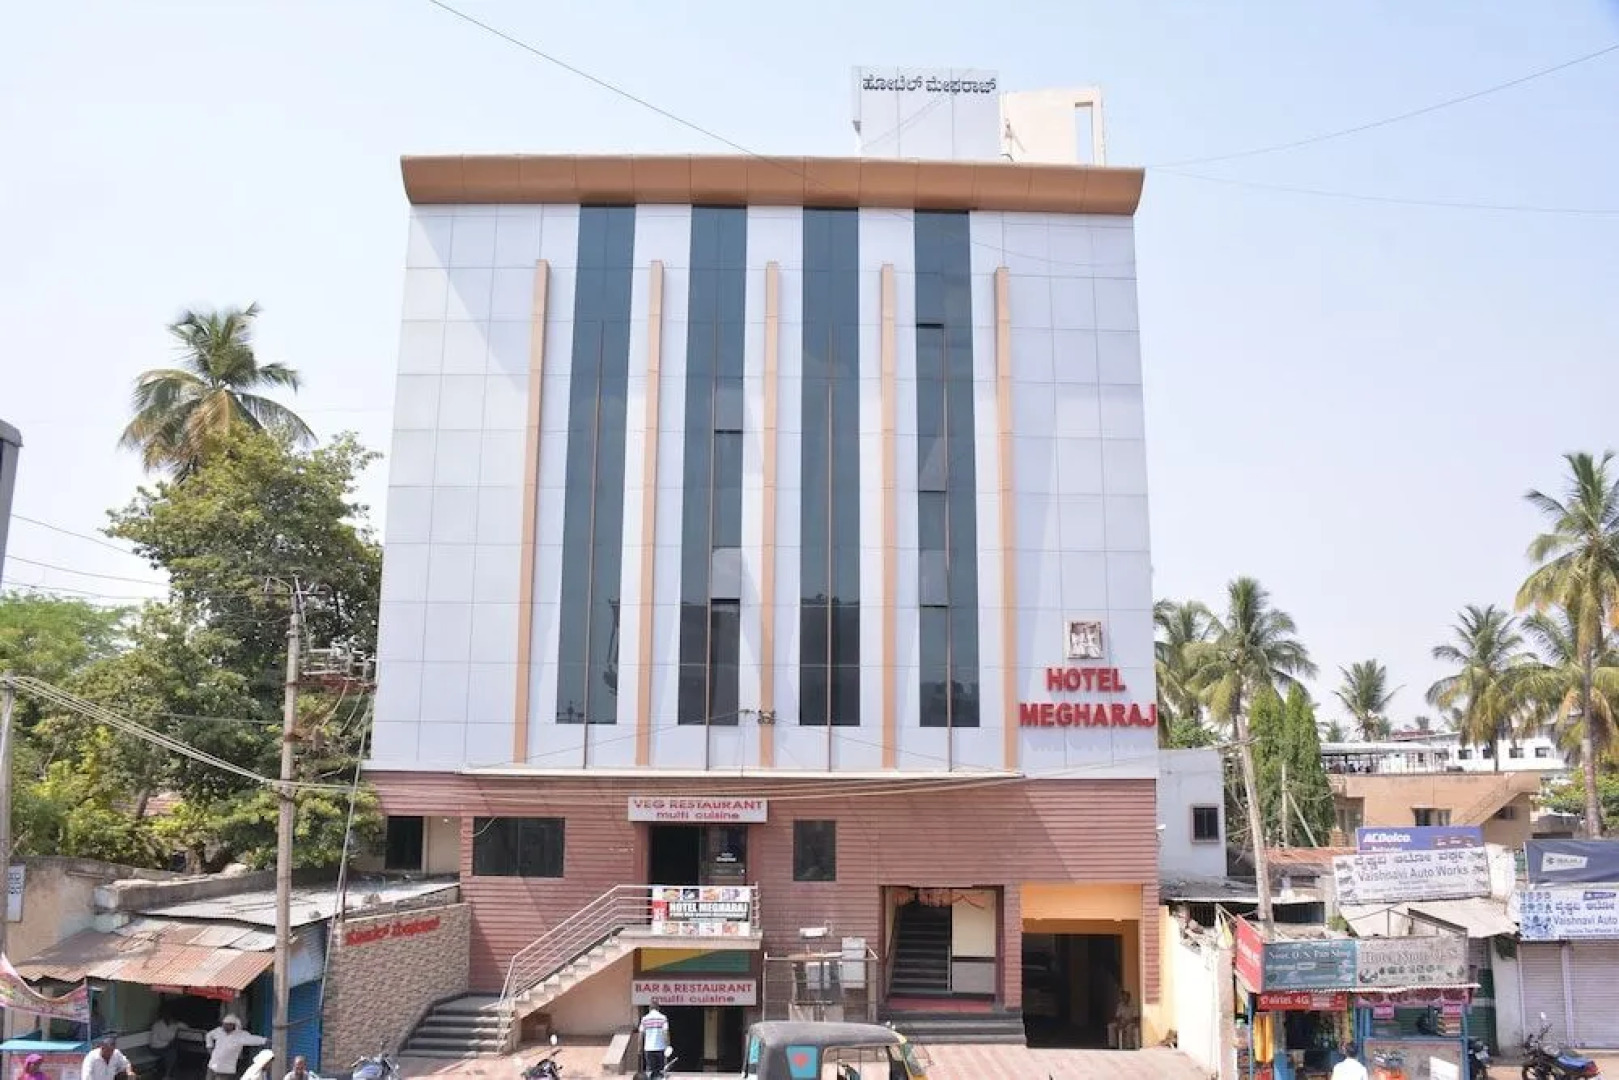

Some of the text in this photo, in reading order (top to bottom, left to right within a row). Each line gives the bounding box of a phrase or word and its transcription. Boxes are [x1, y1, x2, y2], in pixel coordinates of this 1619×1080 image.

[863, 75, 923, 91] ಹೋಟೆಲ್
[1046, 668, 1127, 692] HOTEL
[1019, 702, 1157, 728] MEGHARAJ
[633, 800, 762, 809] VEG RESTAURANT
[656, 811, 739, 819] multi cuisine
[1357, 865, 1469, 882] Vaishnavi Auto Works
[670, 902, 697, 912] HOTEL
[699, 902, 747, 912] MEGHARAJ
[1554, 914, 1618, 925] Vaishnavi Auto
[635, 983, 751, 992] BAR & RESTAURANT
[1269, 996, 1292, 1004] airtel
[1295, 996, 1309, 1004] 4G
